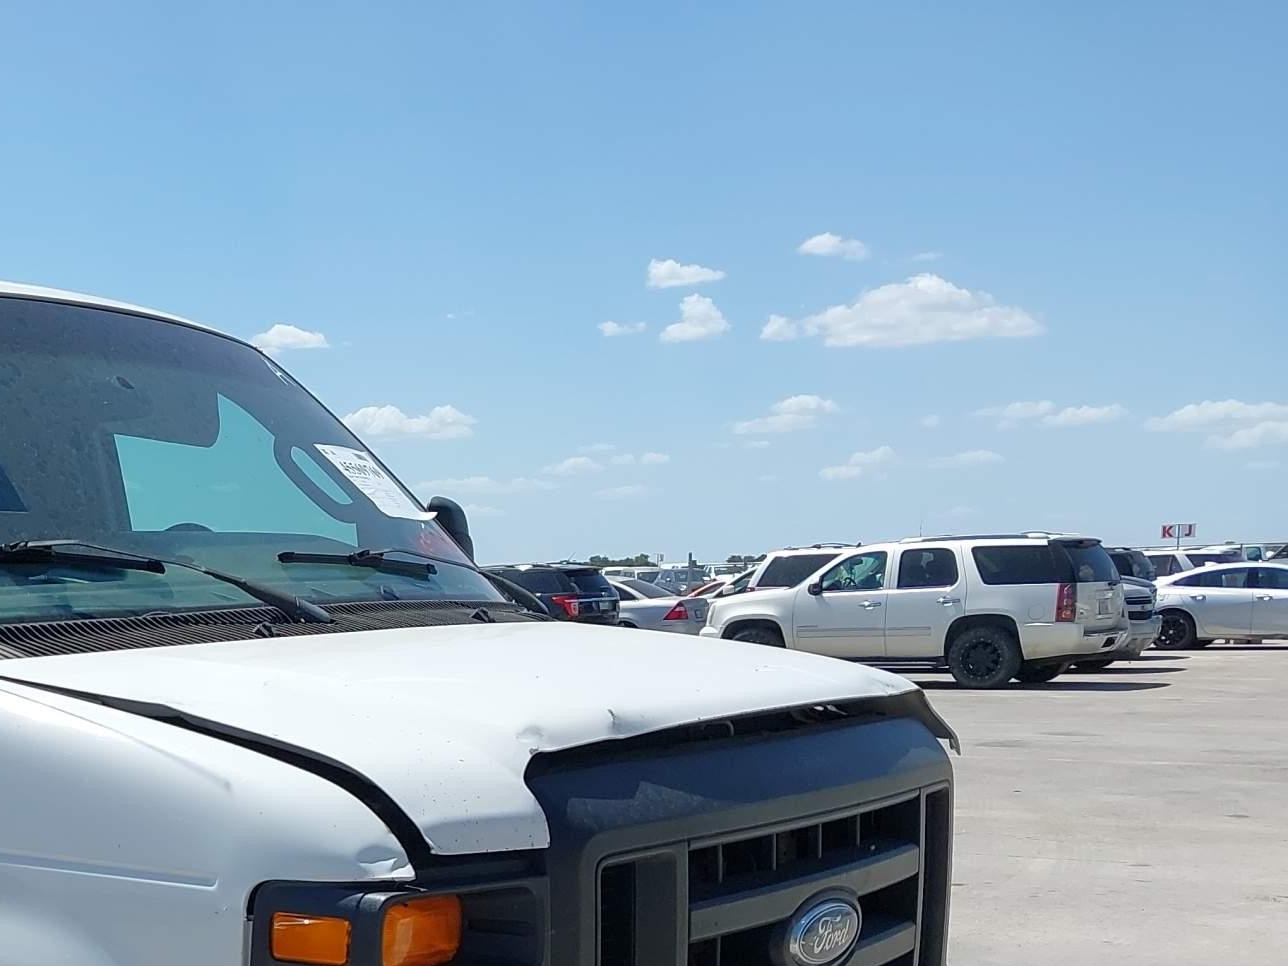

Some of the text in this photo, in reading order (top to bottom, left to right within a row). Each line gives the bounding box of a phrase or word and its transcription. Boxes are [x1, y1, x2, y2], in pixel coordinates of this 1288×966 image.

[1162, 525, 1174, 538] K
[1184, 524, 1193, 537] J
[814, 914, 850, 954] Ford
